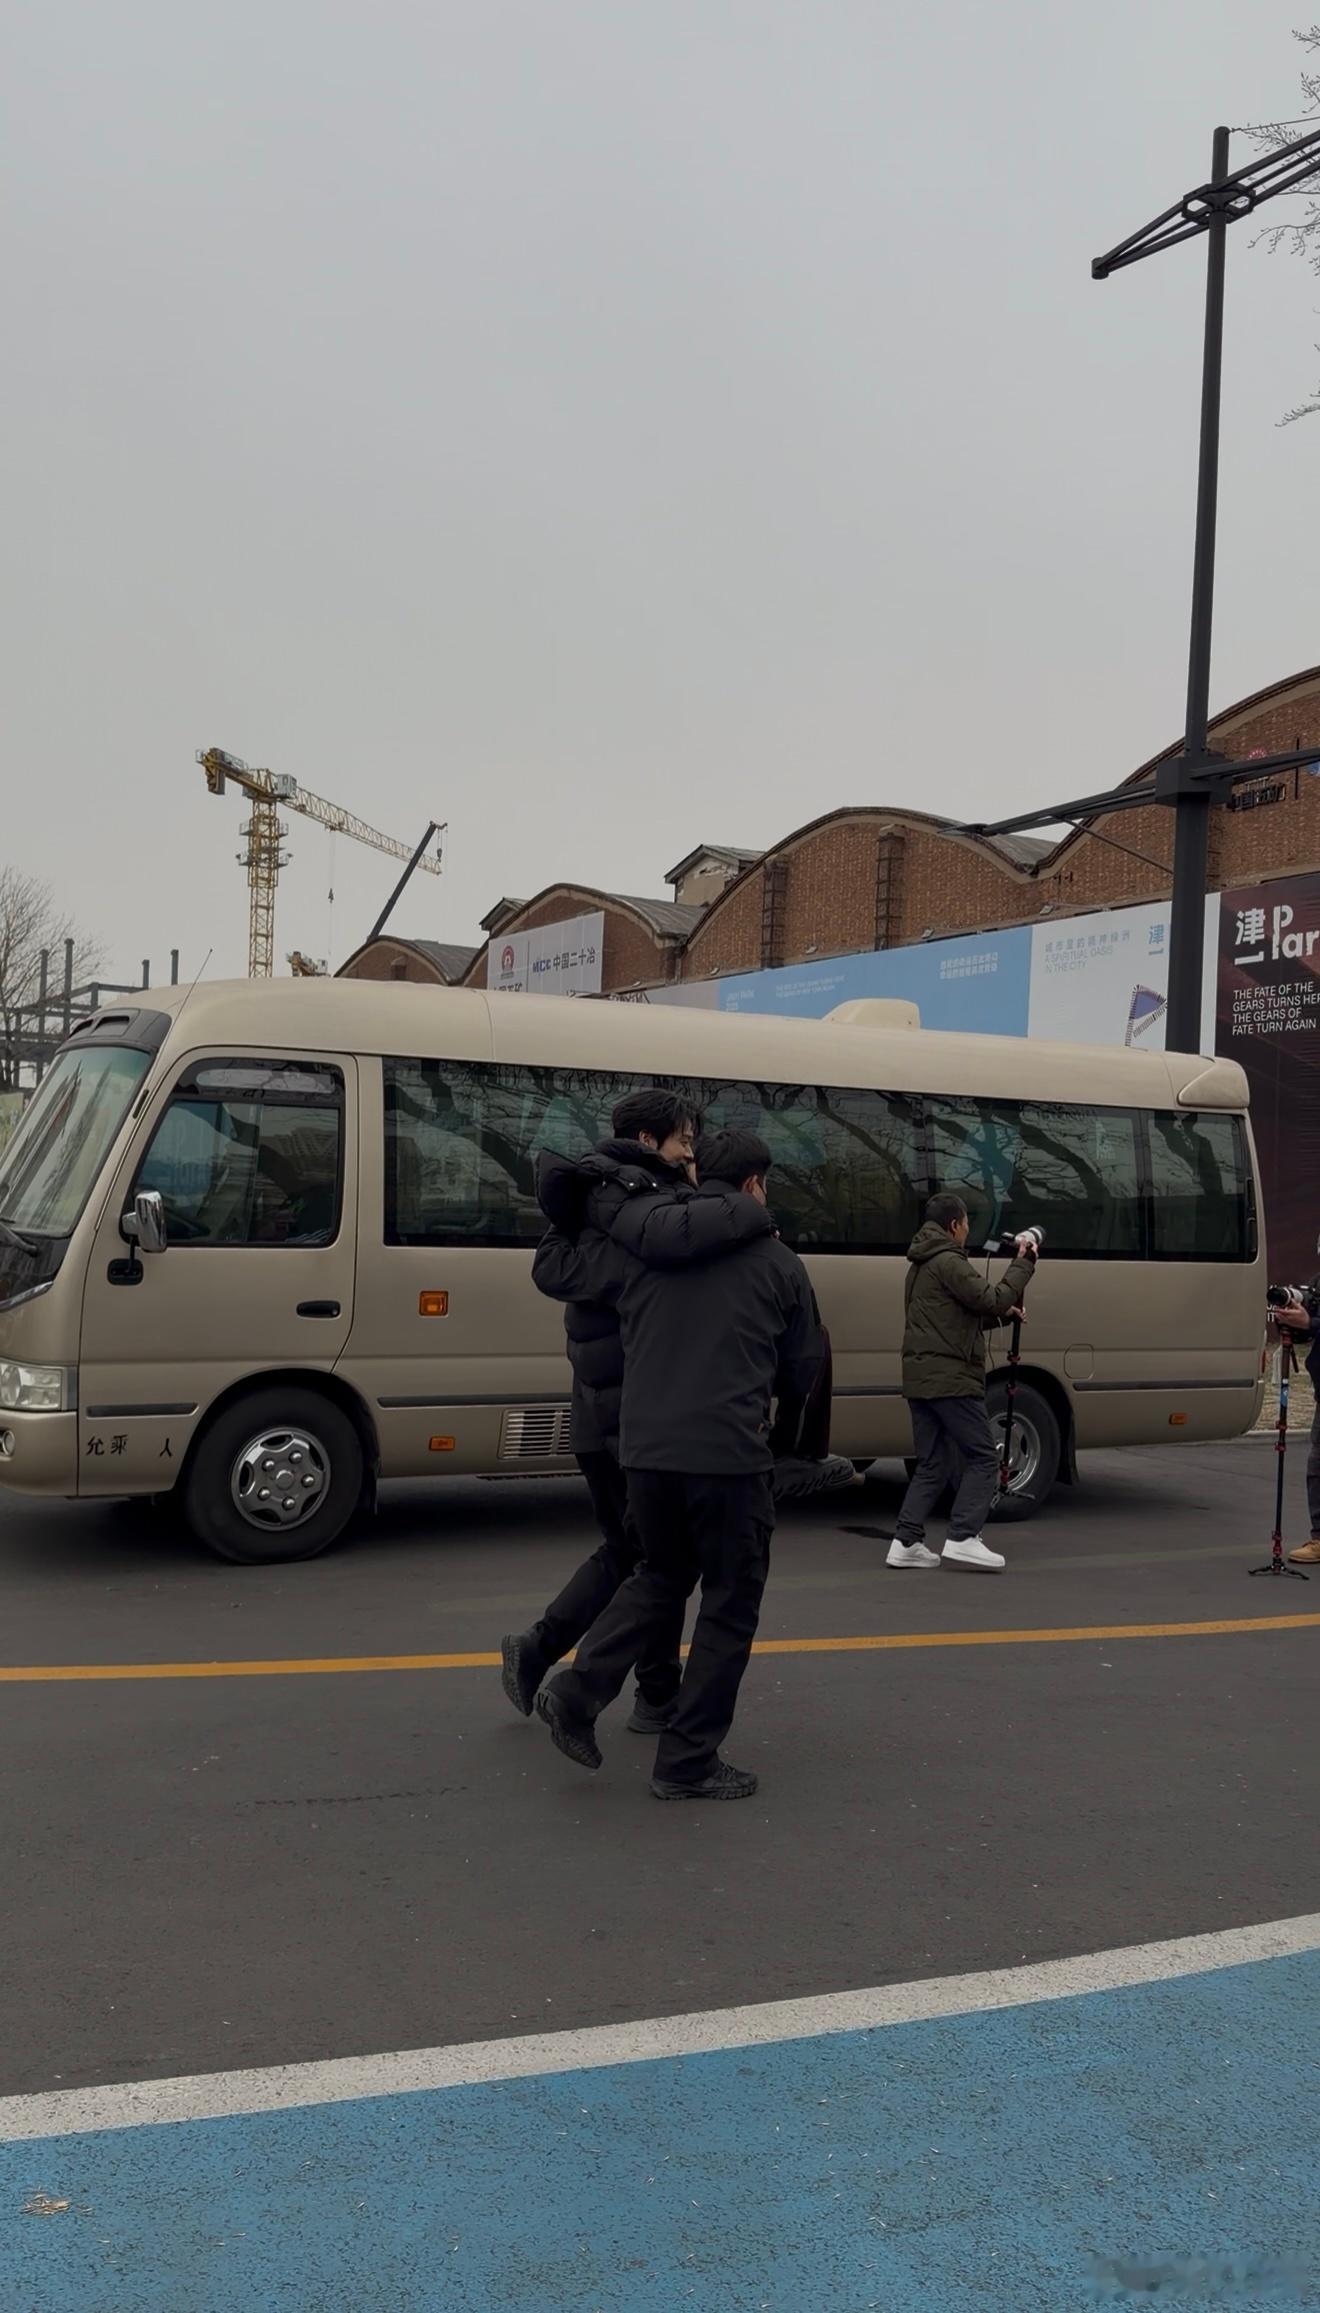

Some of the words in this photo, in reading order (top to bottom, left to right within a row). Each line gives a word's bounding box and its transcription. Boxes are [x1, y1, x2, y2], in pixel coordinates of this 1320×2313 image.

[553, 946, 596, 972] 中国二十冶
[1054, 961, 1068, 972] THE
[1069, 959, 1087, 971] CITY
[1234, 988, 1252, 1000] THE
[1254, 985, 1276, 998] FATE
[1278, 983, 1294, 996] OF
[1295, 981, 1314, 994] THE
[1233, 999, 1265, 1012] GEARS
[1268, 995, 1301, 1009] TURNS
[1233, 1012, 1252, 1024] THE
[1253, 1008, 1286, 1022] GEARS
[1288, 1007, 1302, 1019] OF
[1232, 1024, 1254, 1036] FATE
[1257, 1021, 1283, 1034] TURN
[1285, 1018, 1316, 1032] AGAIN
[159, 1437, 173, 1457] 人
